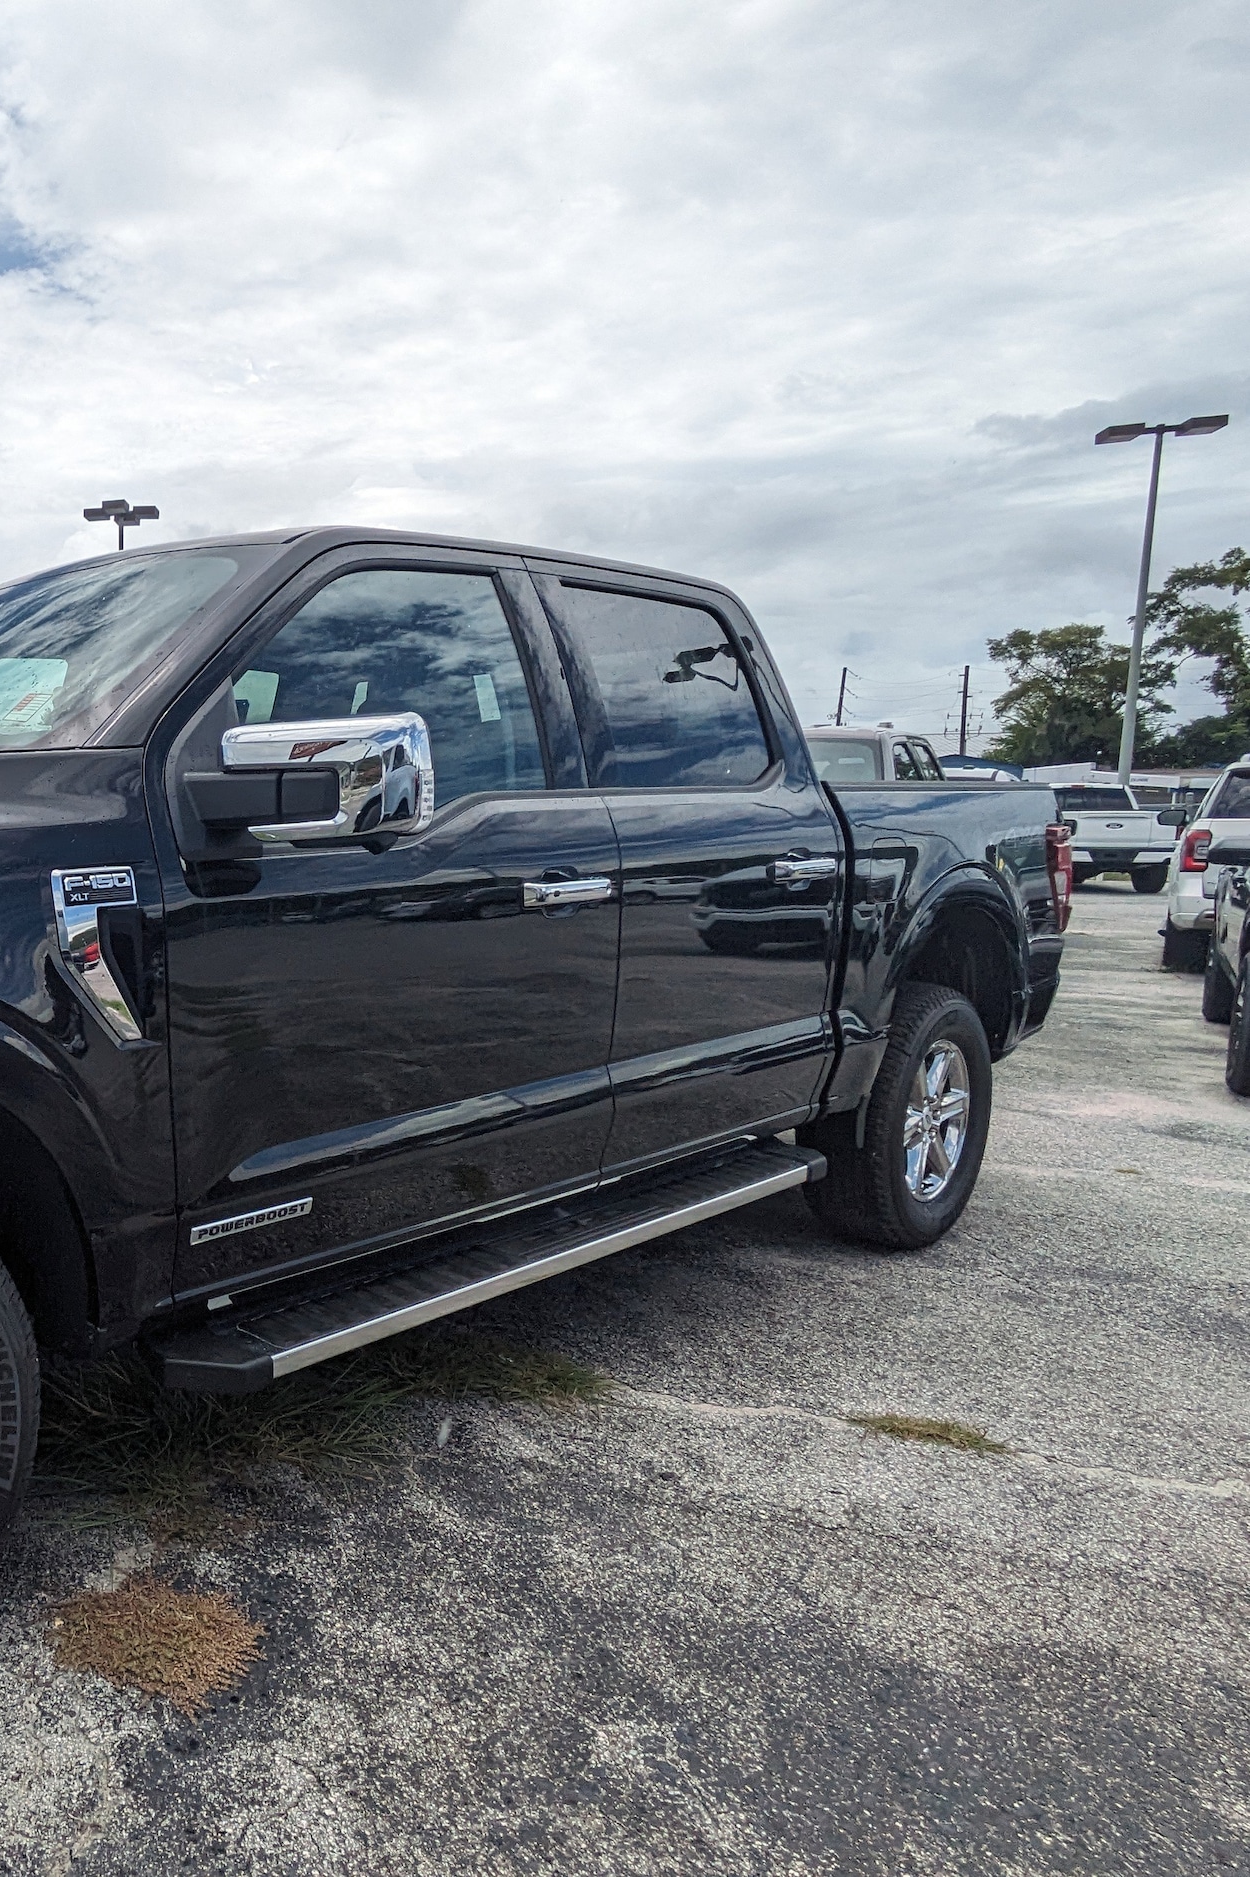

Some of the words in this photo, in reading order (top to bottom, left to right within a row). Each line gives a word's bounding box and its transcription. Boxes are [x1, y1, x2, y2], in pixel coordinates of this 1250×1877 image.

[64, 873, 131, 891] F-150
[69, 892, 90, 902] XLT
[197, 1202, 308, 1240] POWERBOOST
